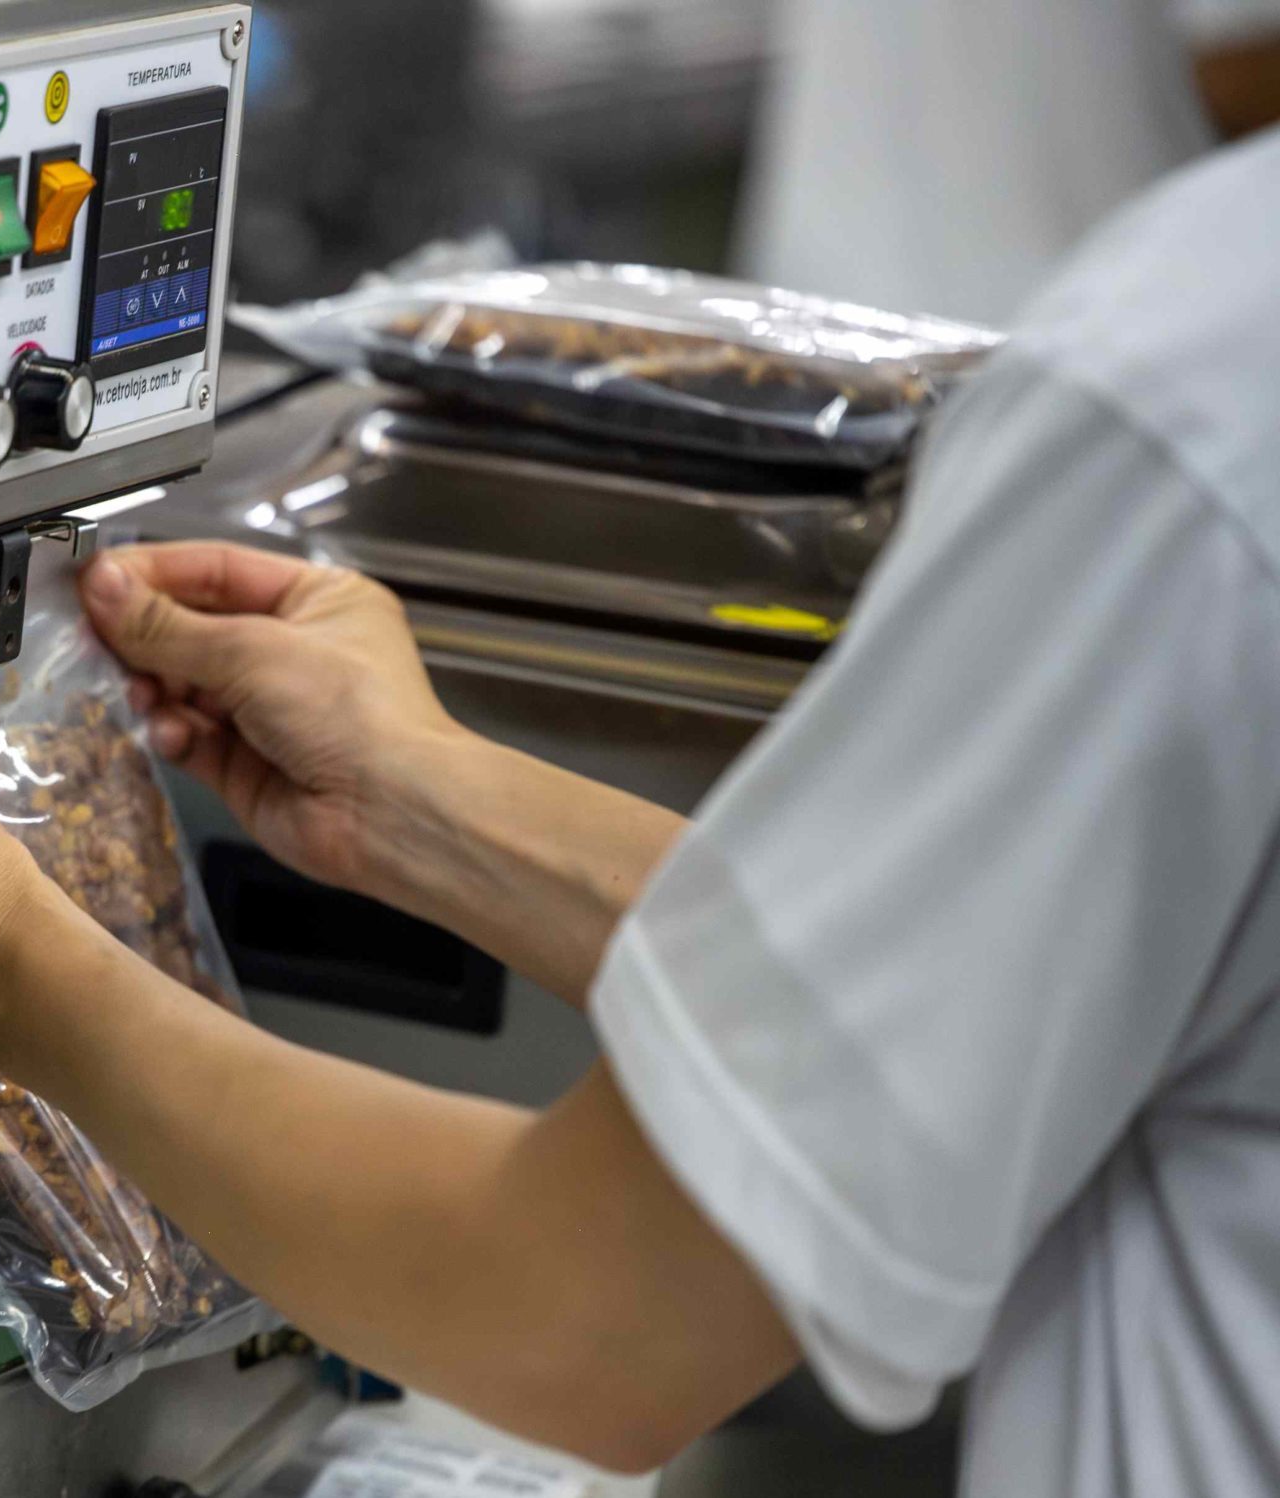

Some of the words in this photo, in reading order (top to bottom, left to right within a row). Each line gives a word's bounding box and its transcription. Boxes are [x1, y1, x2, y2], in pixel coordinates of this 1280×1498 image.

[128, 61, 192, 86] TEMPERATURA
[158, 263, 170, 275] OUT
[177, 258, 190, 270] ALM
[141, 269, 149, 279] AT
[26, 277, 55, 299] DATADOR
[7, 316, 47, 338] VELOCIDADE
